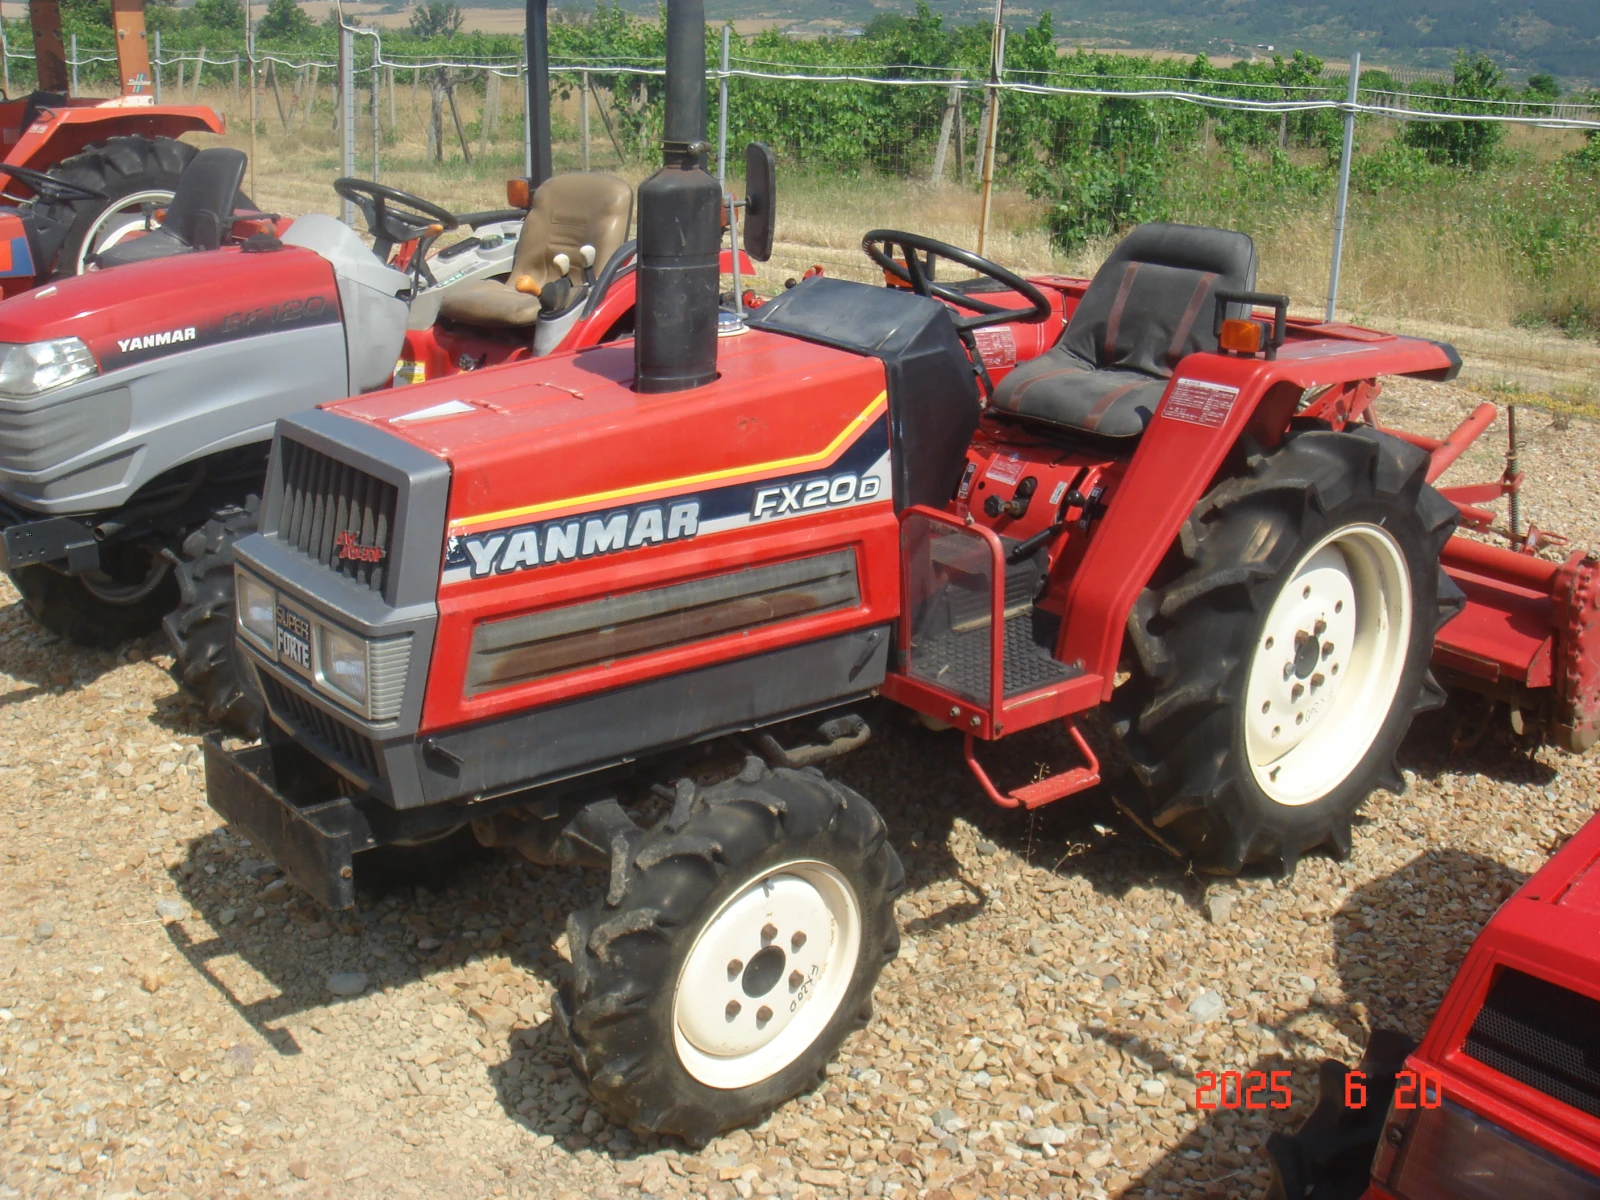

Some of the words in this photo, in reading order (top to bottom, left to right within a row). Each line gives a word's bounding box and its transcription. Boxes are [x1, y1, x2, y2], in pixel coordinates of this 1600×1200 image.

[117, 327, 196, 352] YANMAR
[753, 474, 880, 517] FX20D
[465, 502, 699, 576] YANMAR
[276, 606, 309, 640] SUPER
[277, 626, 310, 669] FORTE
